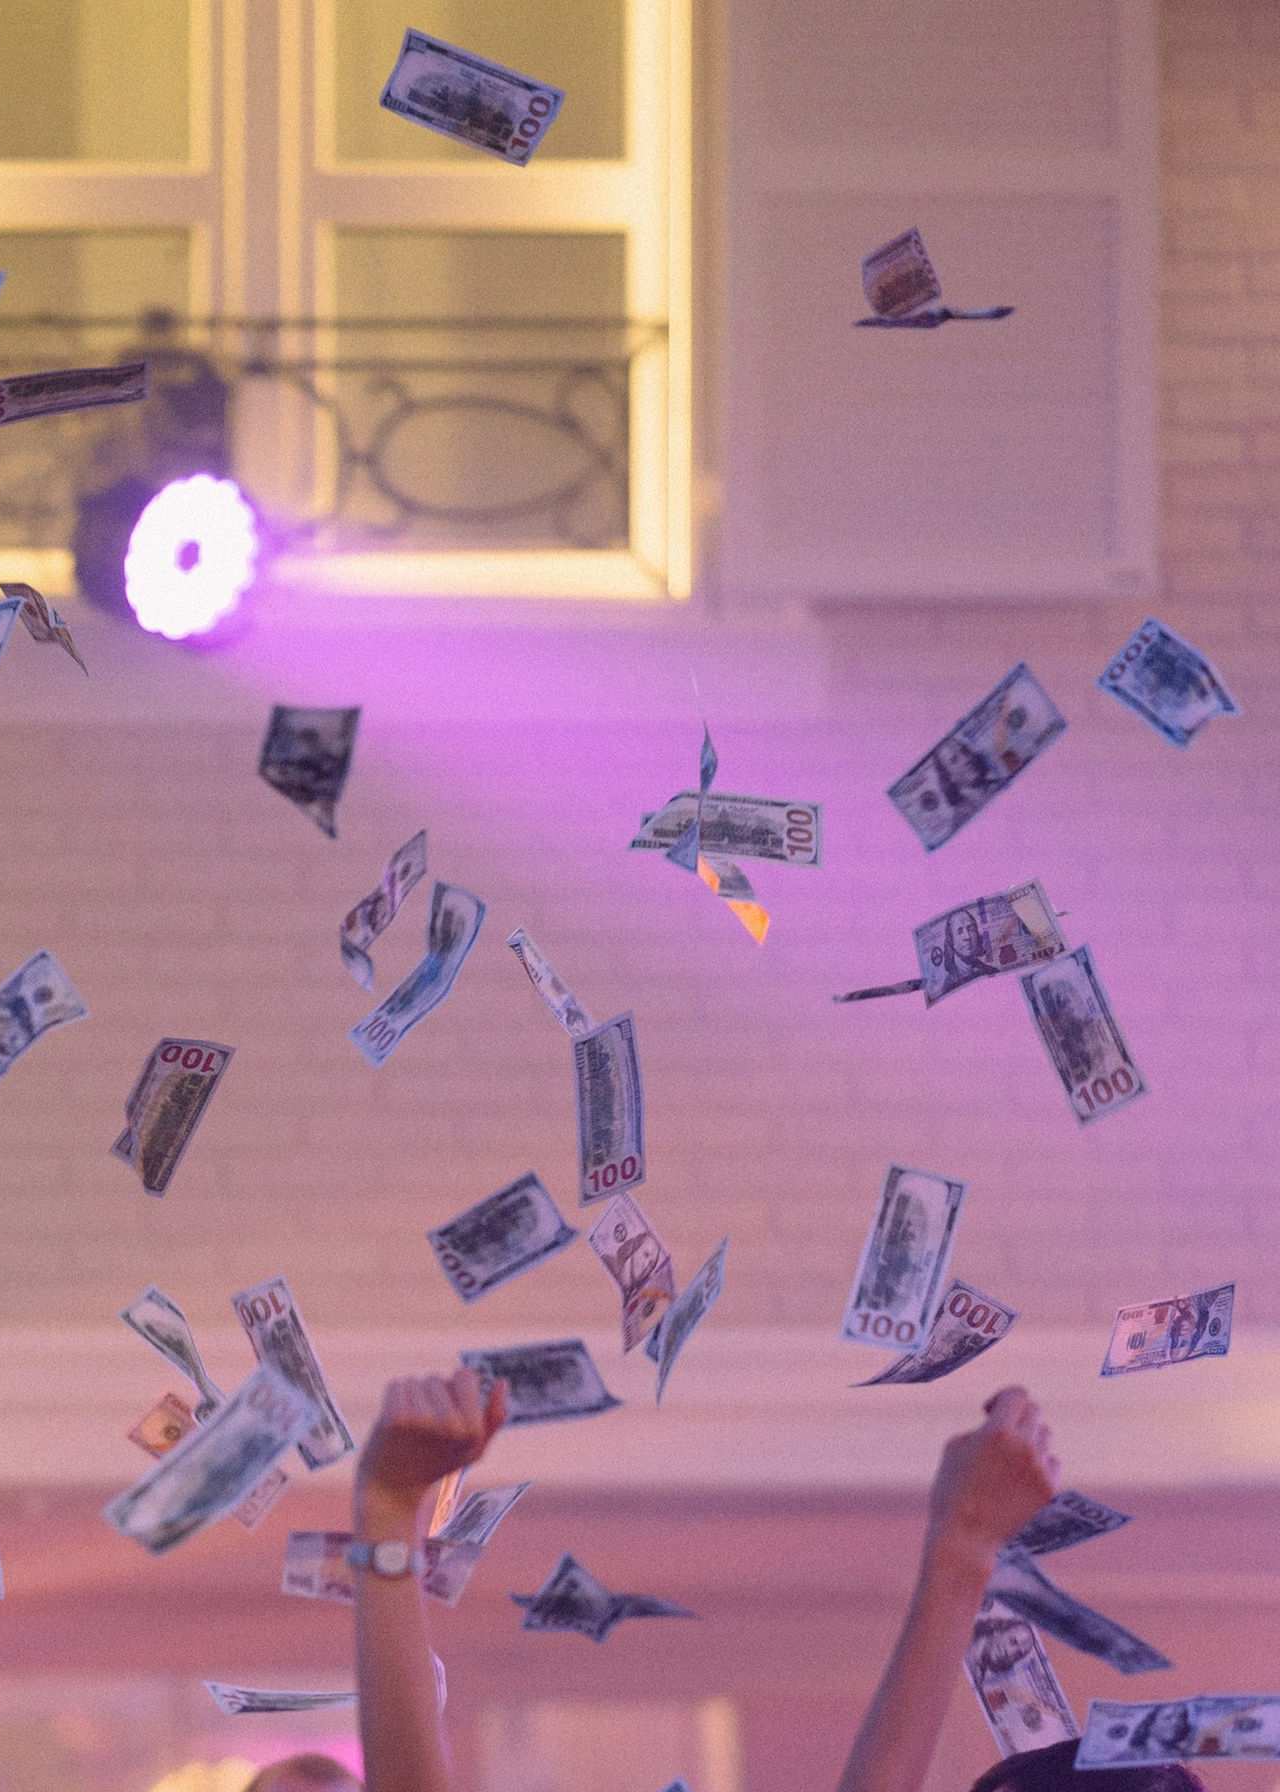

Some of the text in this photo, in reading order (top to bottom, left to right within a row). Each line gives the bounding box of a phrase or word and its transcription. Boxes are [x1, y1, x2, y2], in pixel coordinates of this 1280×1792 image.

[510, 95, 552, 150] 100
[1107, 631, 1154, 684] 100
[786, 808, 814, 856] 100
[363, 1014, 398, 1052] 100
[160, 1044, 216, 1074] 100
[1076, 1066, 1135, 1113] 100
[588, 1155, 638, 1193] 100
[239, 1290, 283, 1329] 100
[856, 1311, 916, 1345] 100
[948, 1292, 1002, 1336] 100
